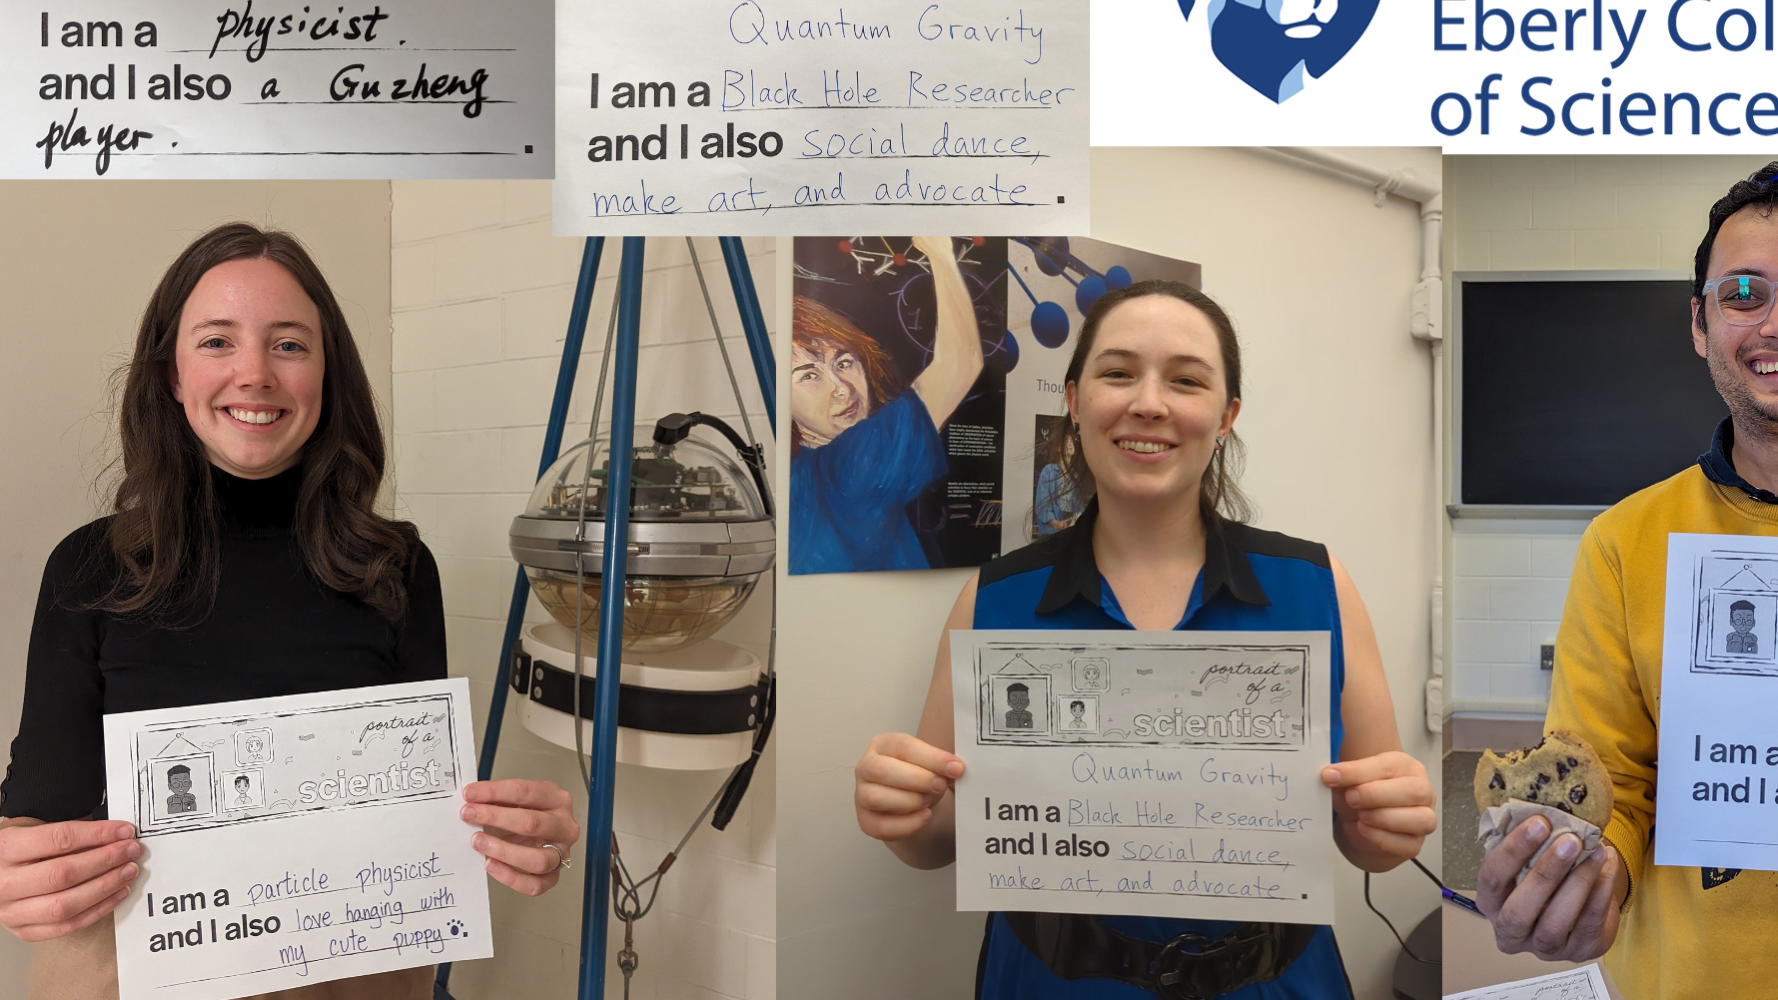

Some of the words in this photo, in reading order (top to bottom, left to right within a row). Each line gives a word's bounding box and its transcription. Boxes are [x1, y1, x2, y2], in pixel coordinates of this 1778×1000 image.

[729, 0, 891, 46] Quantum
[917, 4, 1044, 65] Gravity
[259, 74, 281, 101] a
[721, 69, 804, 112] Black
[822, 69, 882, 106] Hole
[907, 70, 1075, 107] Researcher
[802, 122, 908, 158] social
[591, 178, 683, 217] make
[792, 172, 847, 206] and
[874, 169, 1035, 205] advocate
[1694, 735, 1701, 762] I
[1709, 742, 1758, 765] am
[1071, 751, 1183, 785] Quantum
[1199, 757, 1290, 802] Gravity
[1692, 780, 1750, 803] and
[1759, 778, 1765, 804] I
[246, 867, 330, 908] particle
[354, 851, 442, 896] physicist
[295, 908, 334, 932] love
[345, 900, 405, 930] hanging
[420, 886, 456, 916] with
[279, 945, 310, 978] my
[328, 930, 369, 958] cute
[393, 925, 446, 956] puppy
